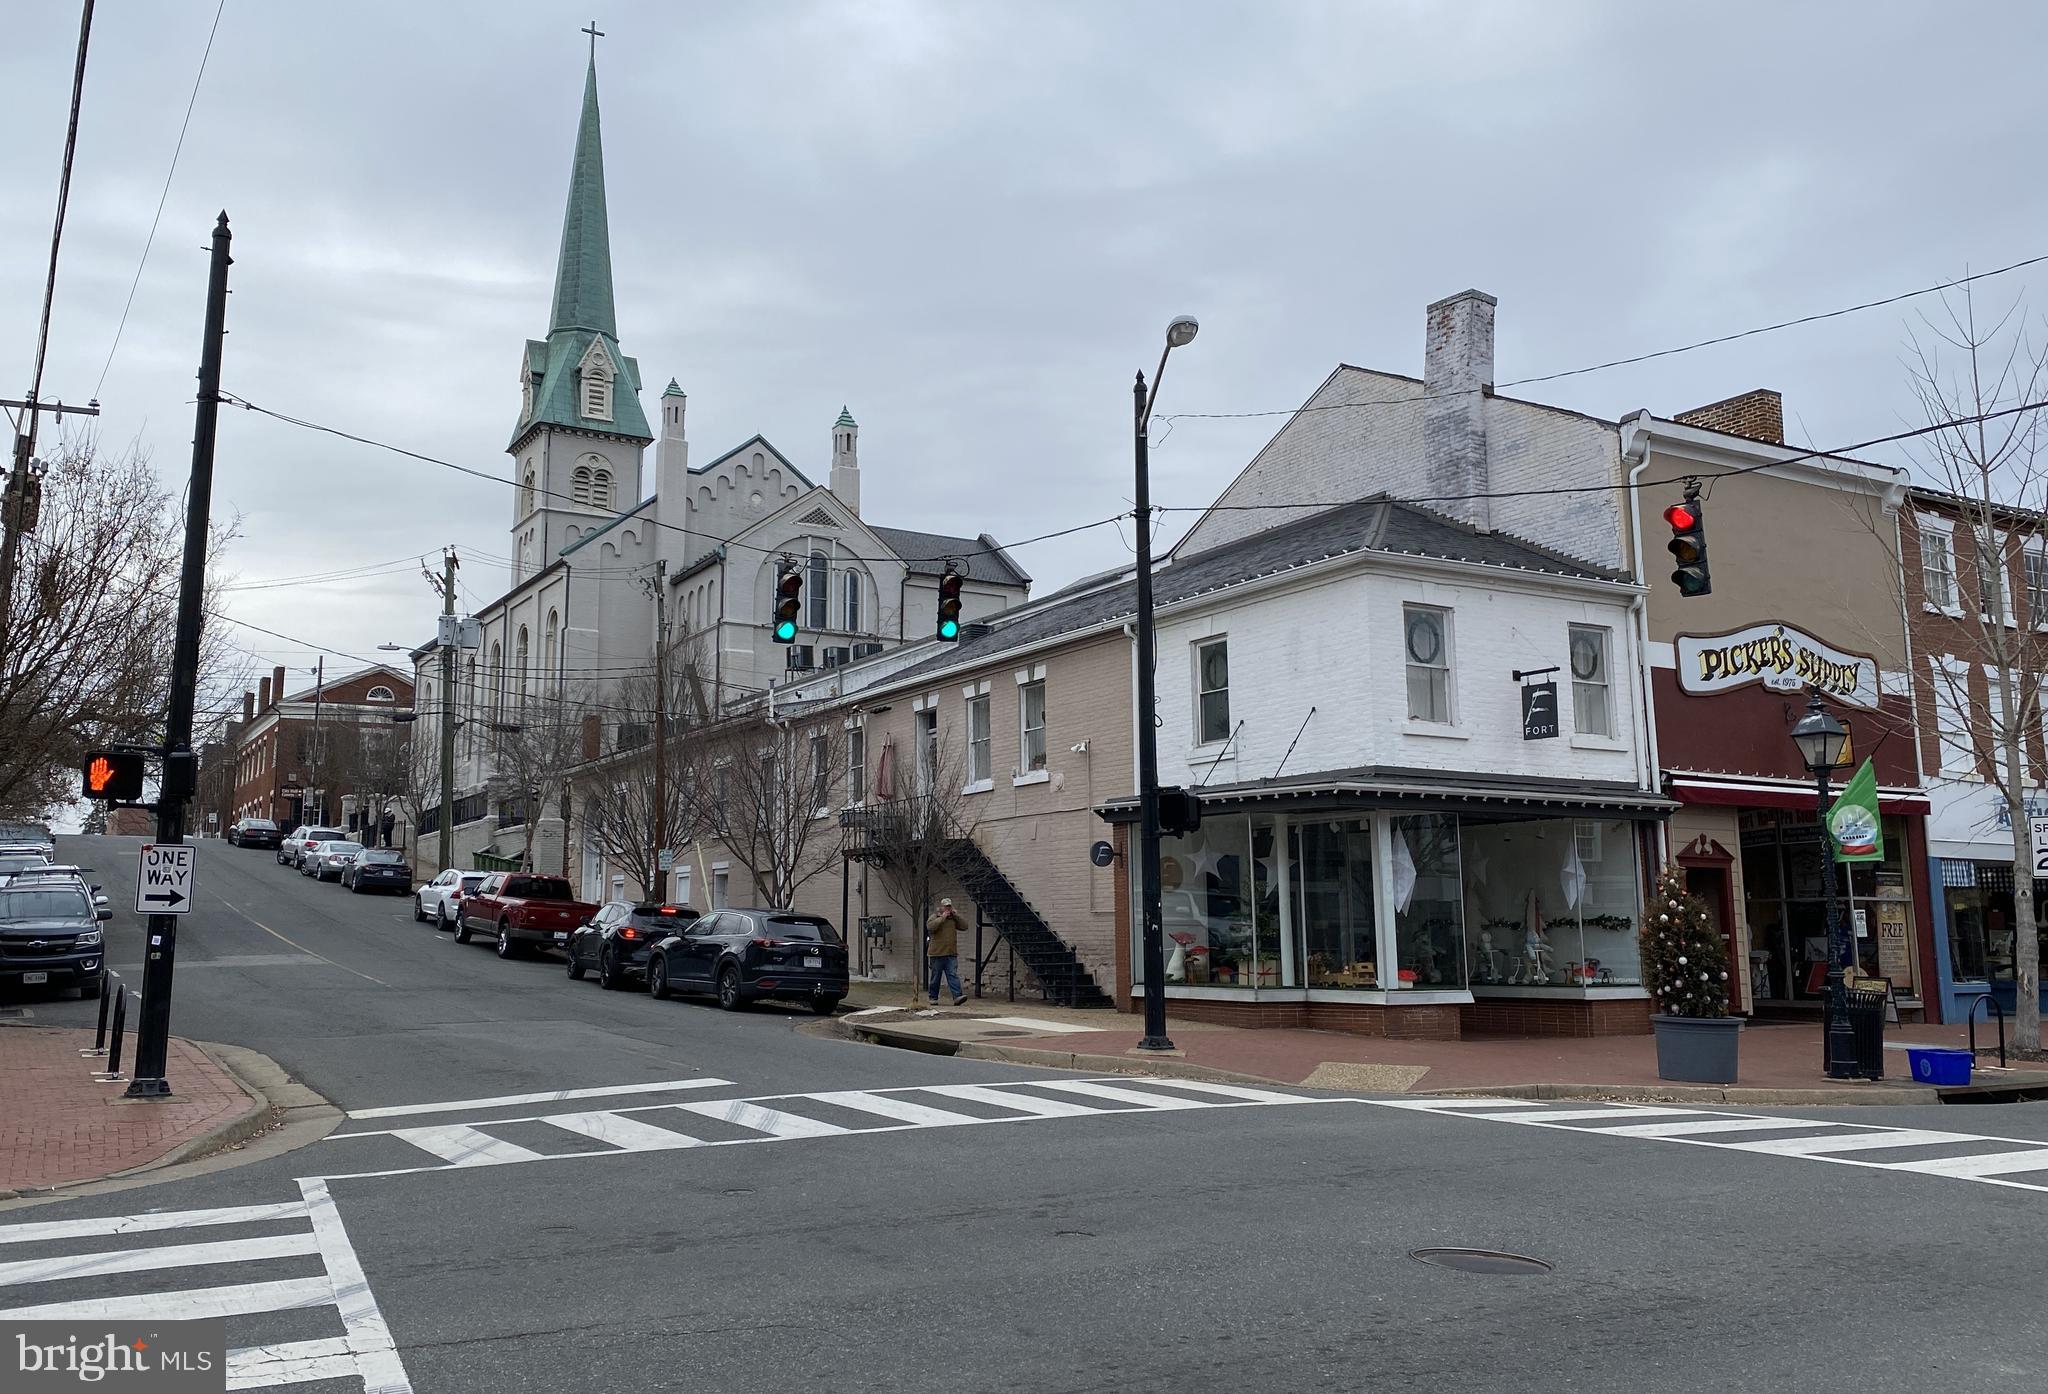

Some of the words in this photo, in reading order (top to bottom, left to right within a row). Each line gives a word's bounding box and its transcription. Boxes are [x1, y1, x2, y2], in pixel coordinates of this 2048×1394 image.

[1698, 626, 1793, 681] PICKER'S
[1795, 647, 1861, 695] SUPPLY
[1525, 725, 1554, 735] FORT
[148, 850, 188, 867] ONE
[147, 869, 188, 886] WAY
[1881, 922, 1904, 938] FREE
